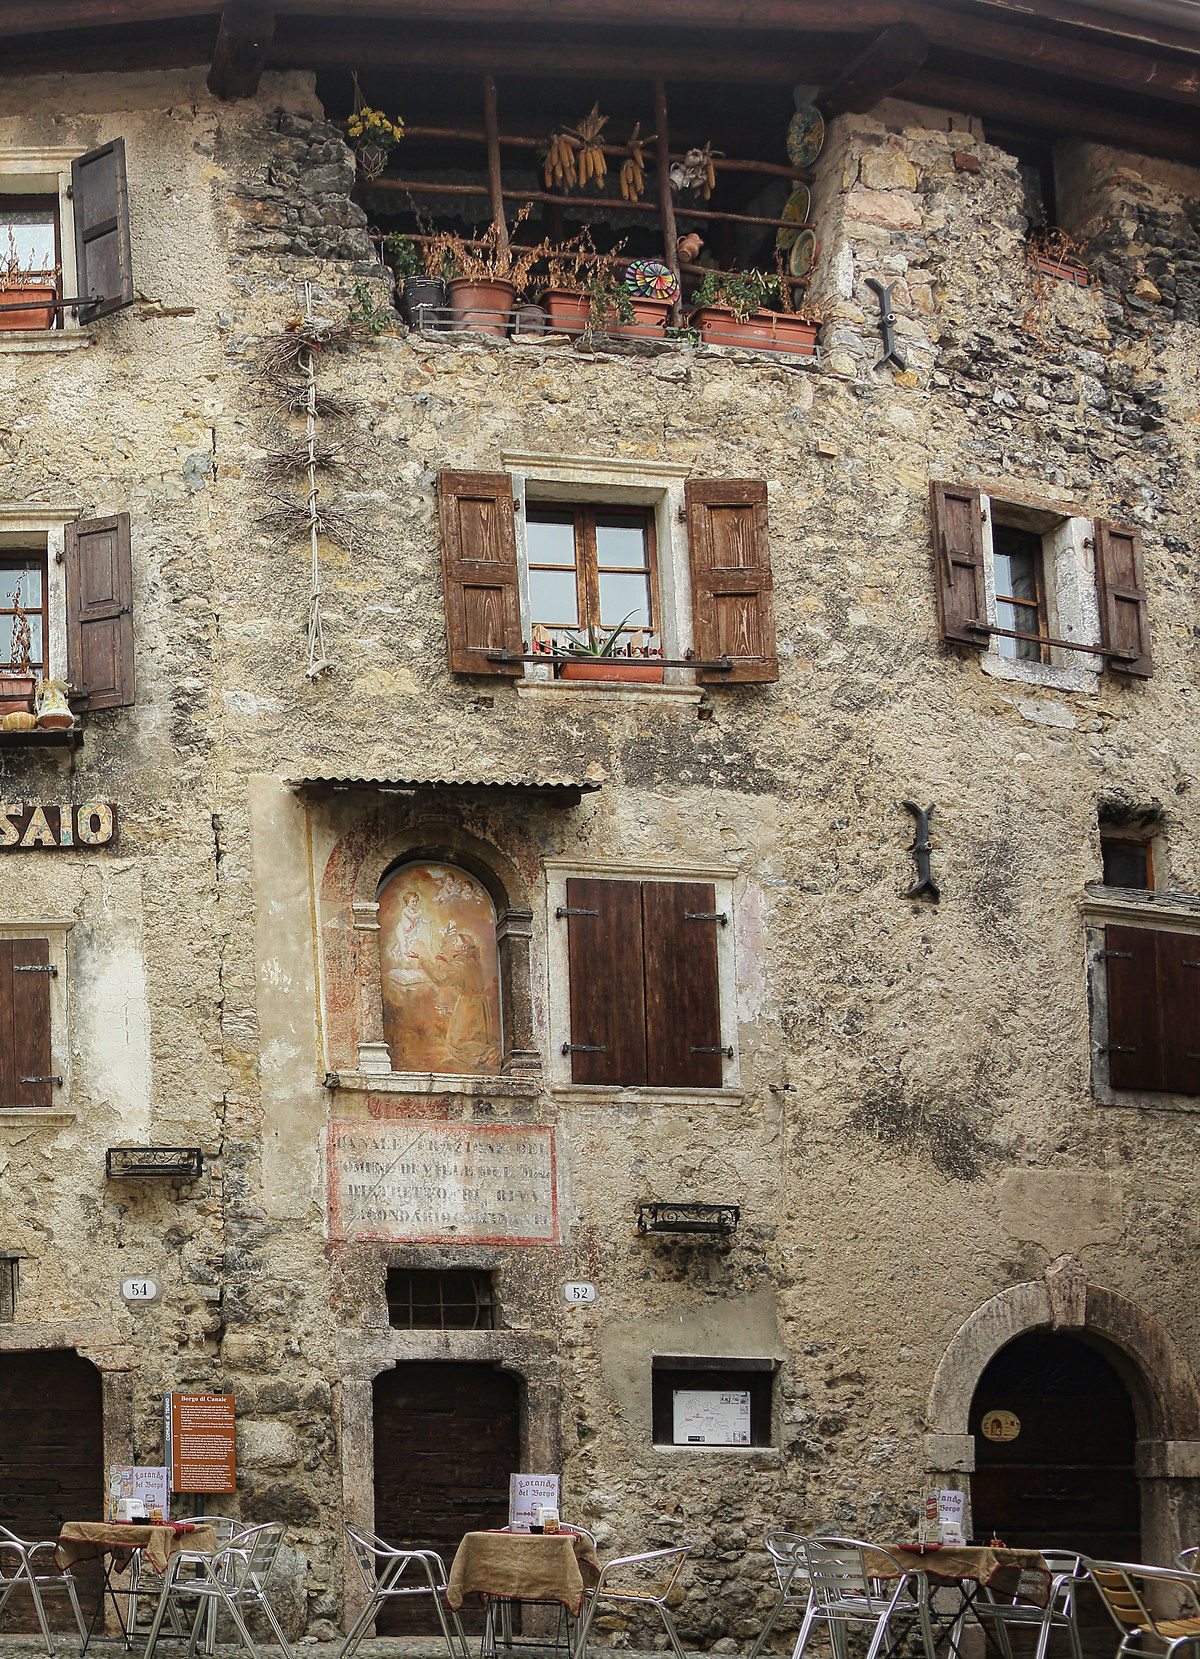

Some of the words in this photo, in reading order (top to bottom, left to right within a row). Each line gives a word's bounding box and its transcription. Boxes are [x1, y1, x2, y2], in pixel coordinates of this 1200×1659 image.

[337, 1161, 395, 1175] OMUNE
[131, 1282, 148, 1296] 54
[573, 1286, 588, 1299] 52
[180, 1395, 199, 1403] Borgo
[135, 1472, 164, 1481] Locanda
[145, 1480, 163, 1489] Borgo
[518, 1480, 556, 1489] Locanda
[531, 1489, 555, 1497] Borgo
[941, 1495, 962, 1504] anda
